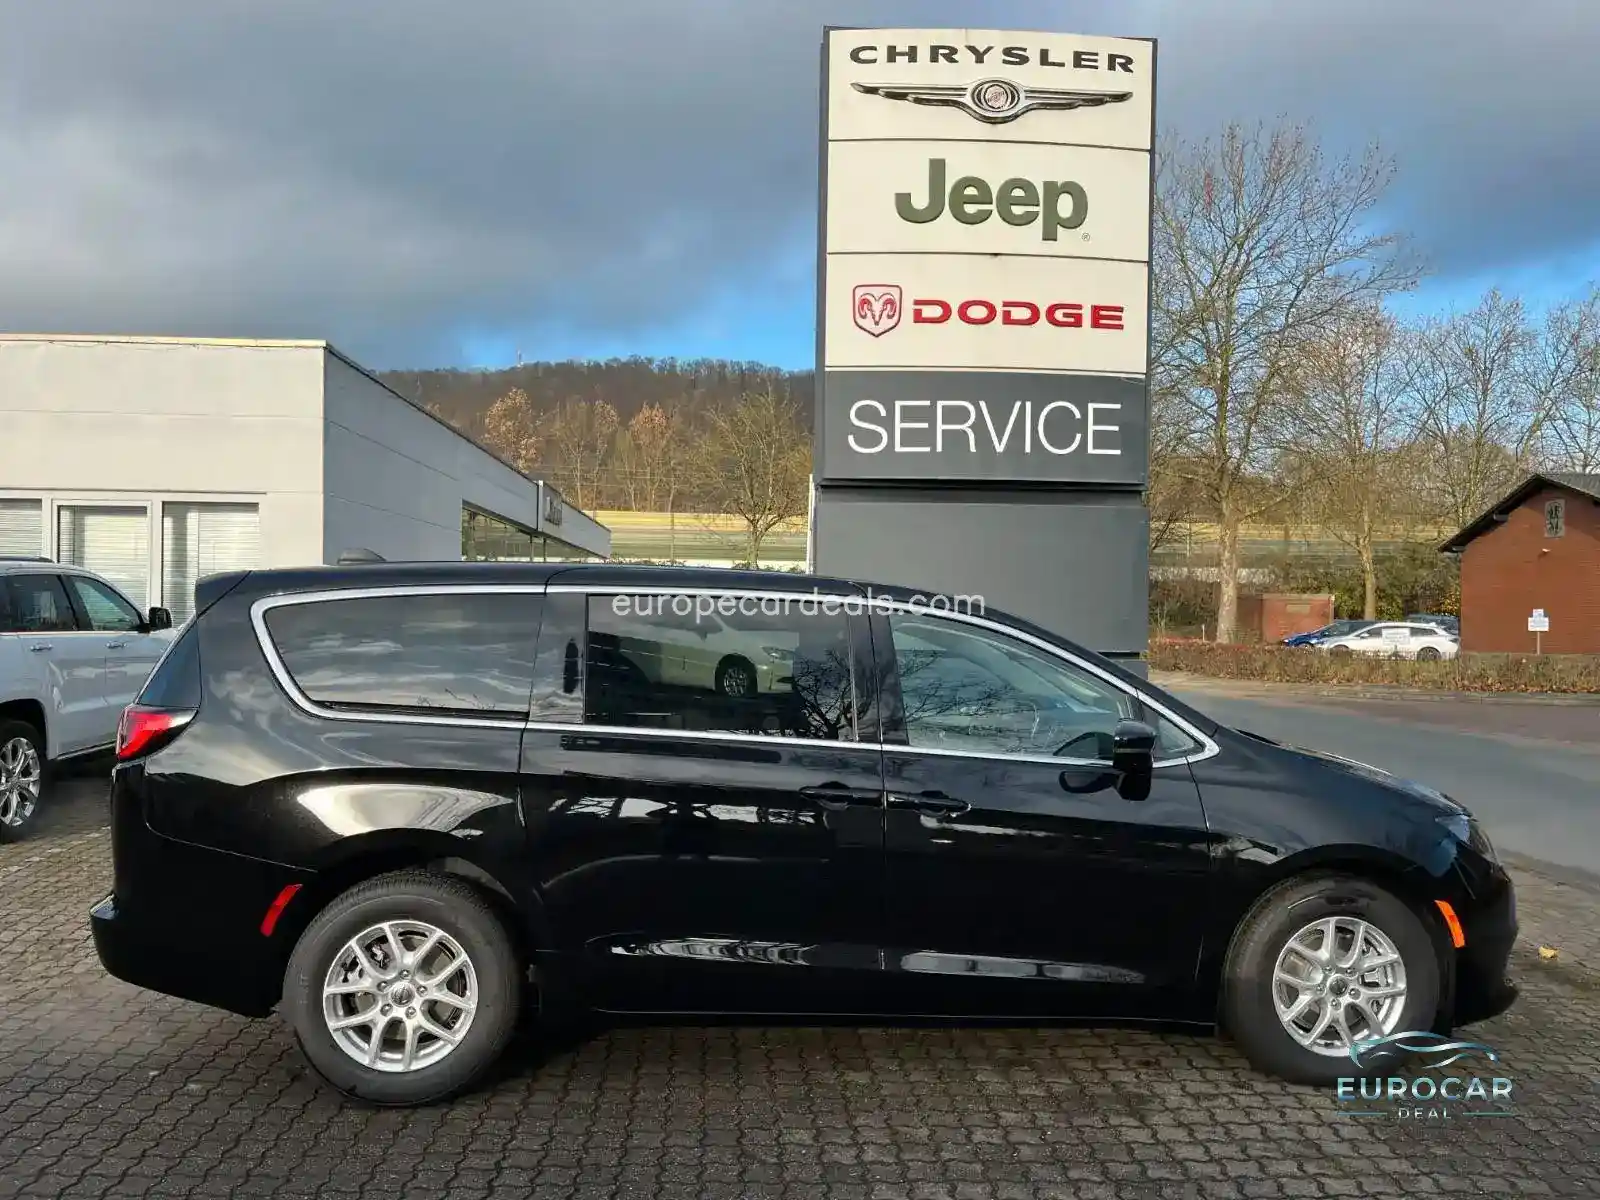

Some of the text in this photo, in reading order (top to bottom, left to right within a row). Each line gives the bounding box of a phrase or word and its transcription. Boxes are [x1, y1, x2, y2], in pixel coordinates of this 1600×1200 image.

[850, 45, 1134, 73] CHRYSLER
[895, 158, 1088, 241] Jeep
[913, 299, 1124, 330] DODGE
[848, 399, 1122, 456] SERVICE
